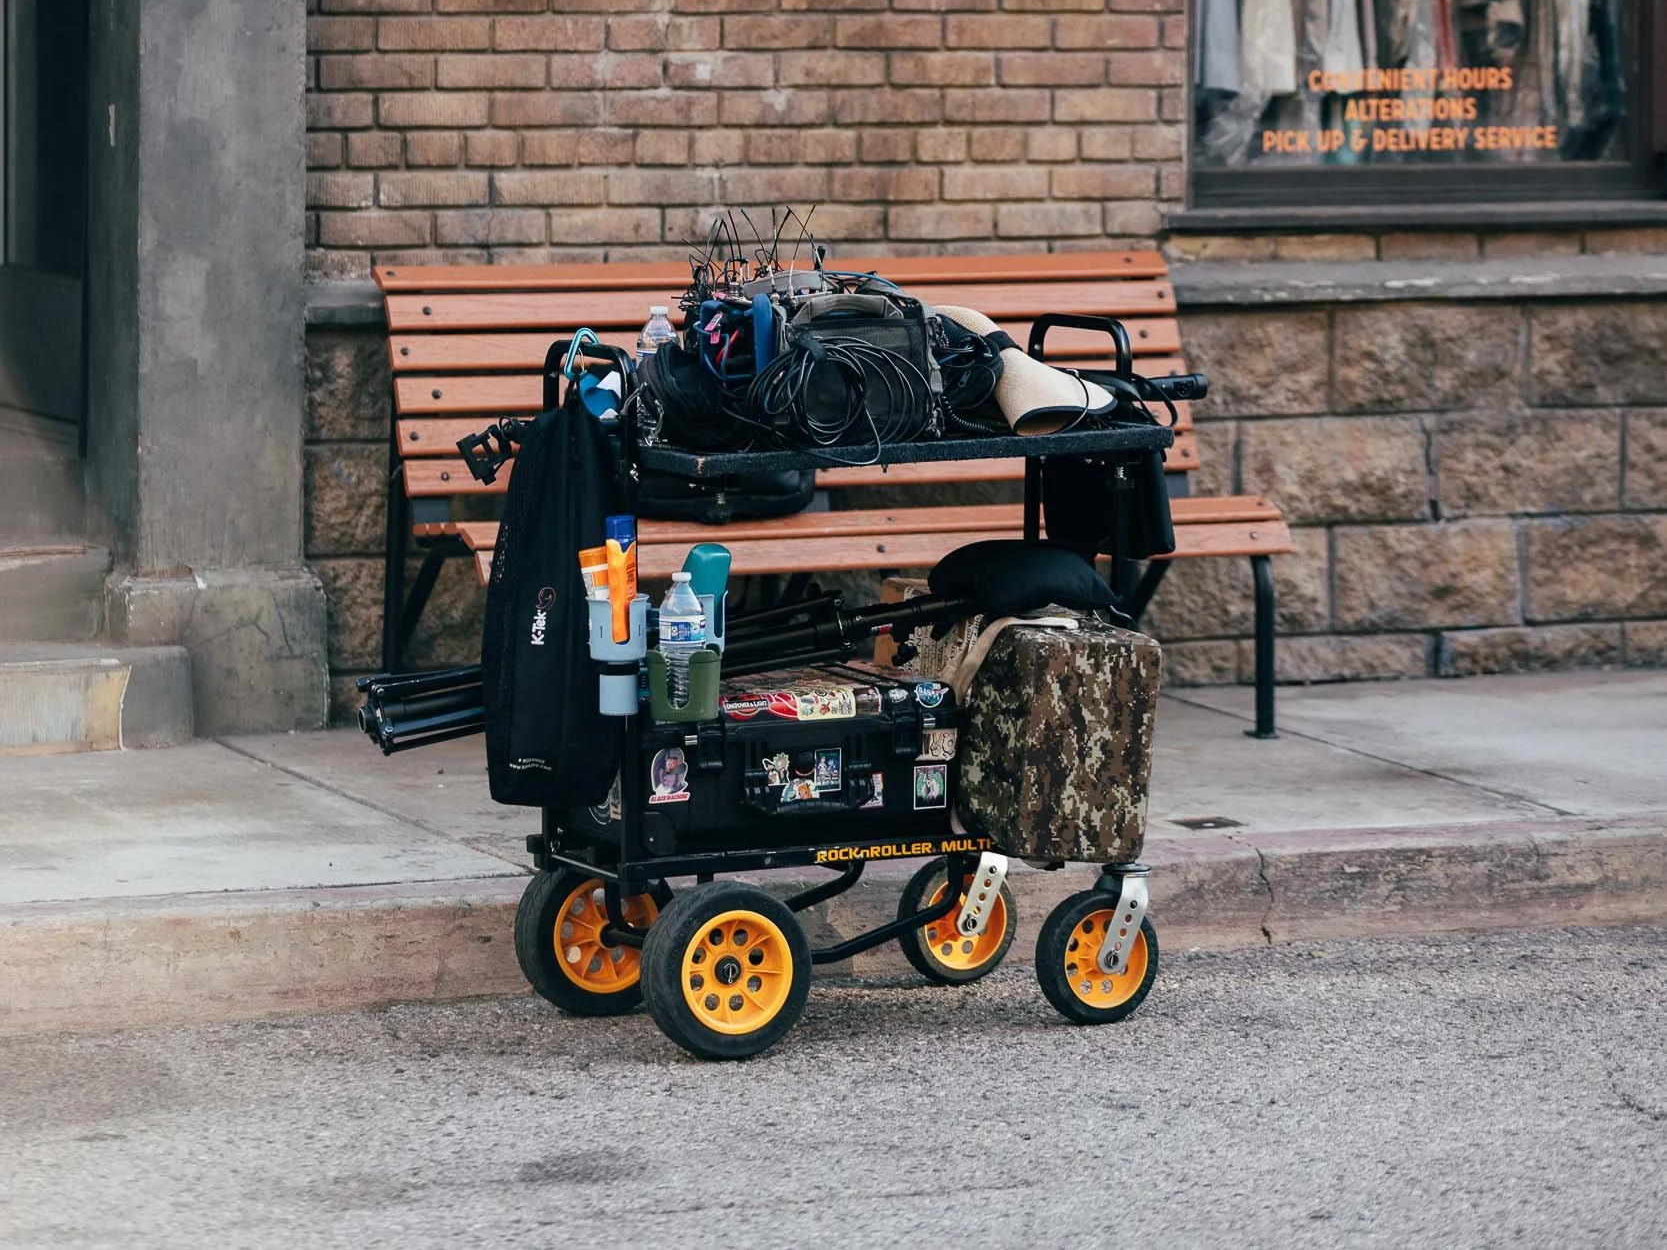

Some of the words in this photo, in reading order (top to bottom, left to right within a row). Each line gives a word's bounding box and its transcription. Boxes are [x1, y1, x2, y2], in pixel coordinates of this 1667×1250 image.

[1307, 68, 1438, 93] CONVENIENT
[1443, 67, 1514, 91] HOURS
[1343, 97, 1479, 122] ALTERATIONS
[1262, 129, 1311, 153] PICK
[1316, 129, 1345, 153] UP
[1349, 129, 1369, 152] &
[1372, 127, 1469, 152] DELIVERY
[1474, 125, 1559, 150] SERVICE
[531, 610, 547, 645] K-Tek
[816, 841, 933, 864] ROCKnROLLER
